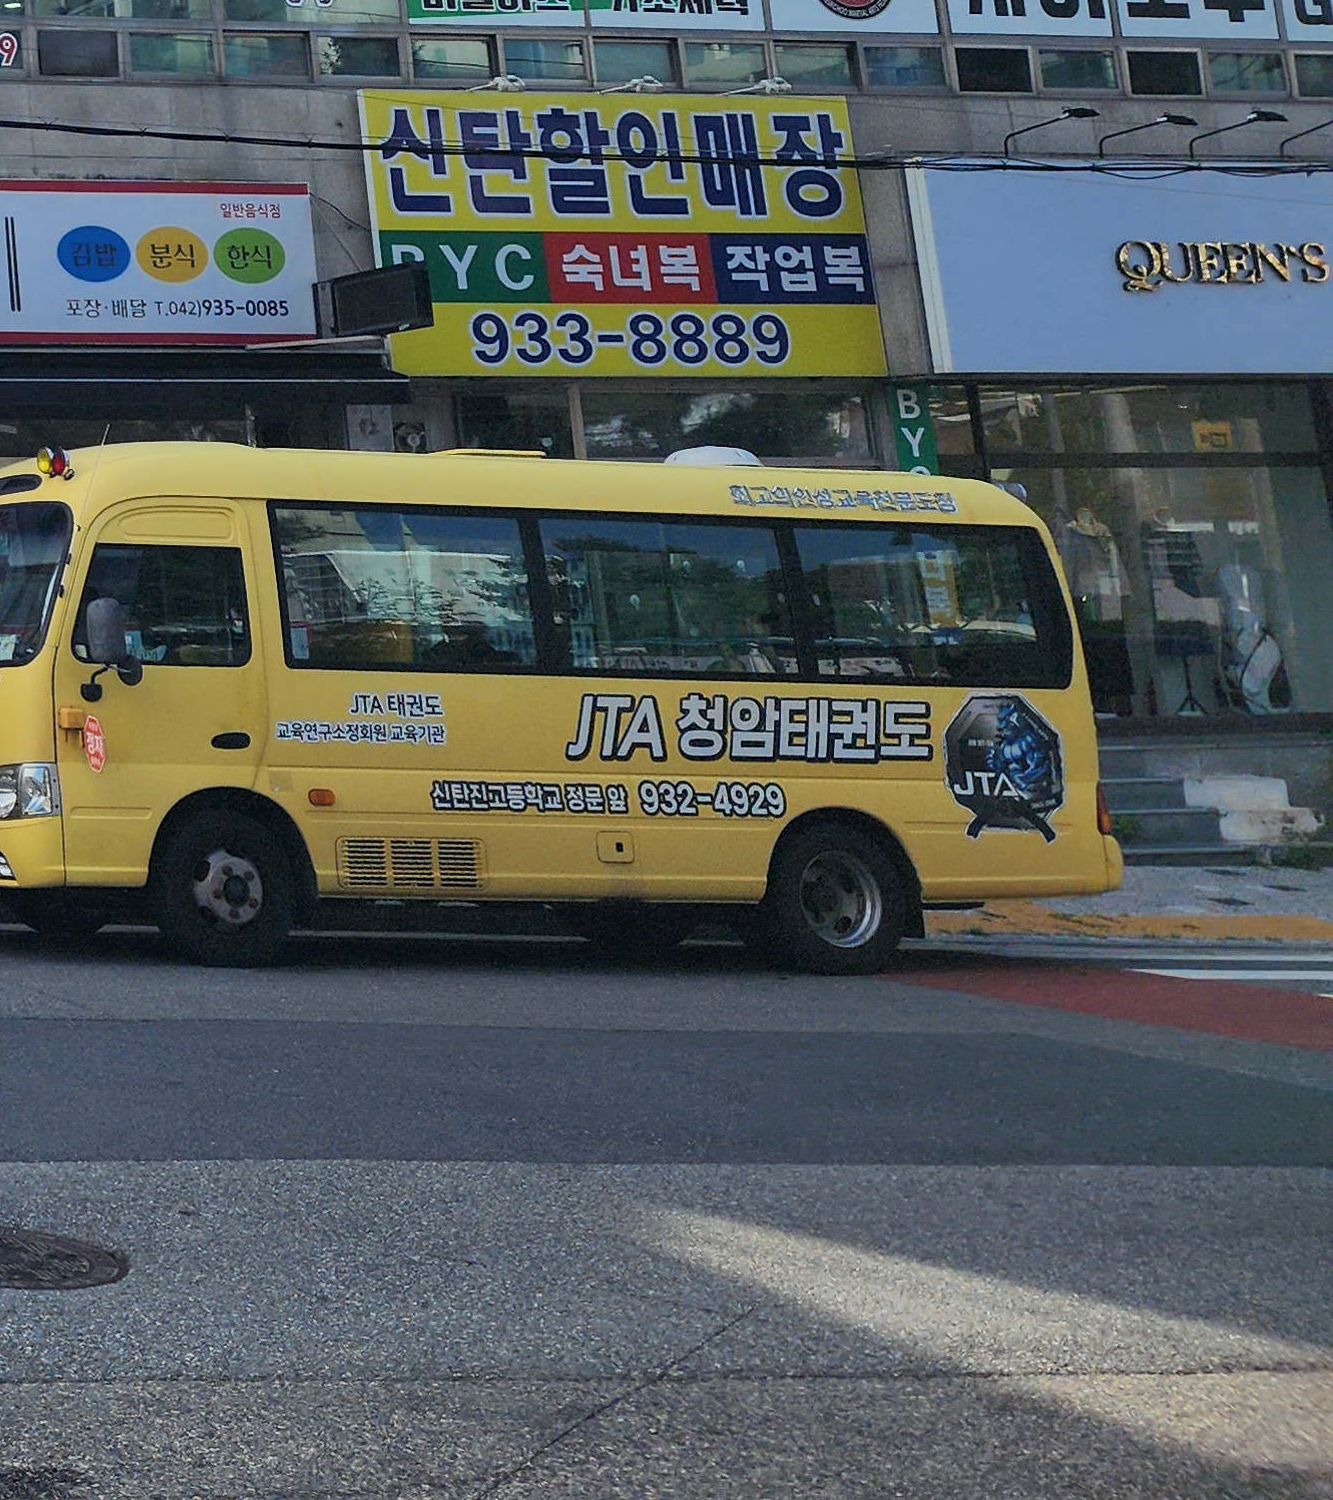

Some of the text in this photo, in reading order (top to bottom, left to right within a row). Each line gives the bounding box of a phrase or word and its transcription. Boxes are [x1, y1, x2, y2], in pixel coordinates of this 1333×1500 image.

[219, 202, 282, 220] 일반음식점
[69, 240, 118, 270] 김밥
[148, 241, 197, 271] 분식
[226, 243, 273, 273] 한식
[561, 243, 701, 293] 숙녀복
[726, 244, 865, 293] 작업복
[470, 310, 791, 366] 933-8889
[349, 693, 445, 718] JTA 태권도
[389, 723, 447, 746] 교육기관
[566, 693, 933, 765] JTA 청암태권도
[637, 780, 787, 818] 932-4929
[953, 770, 1028, 799] JTA
